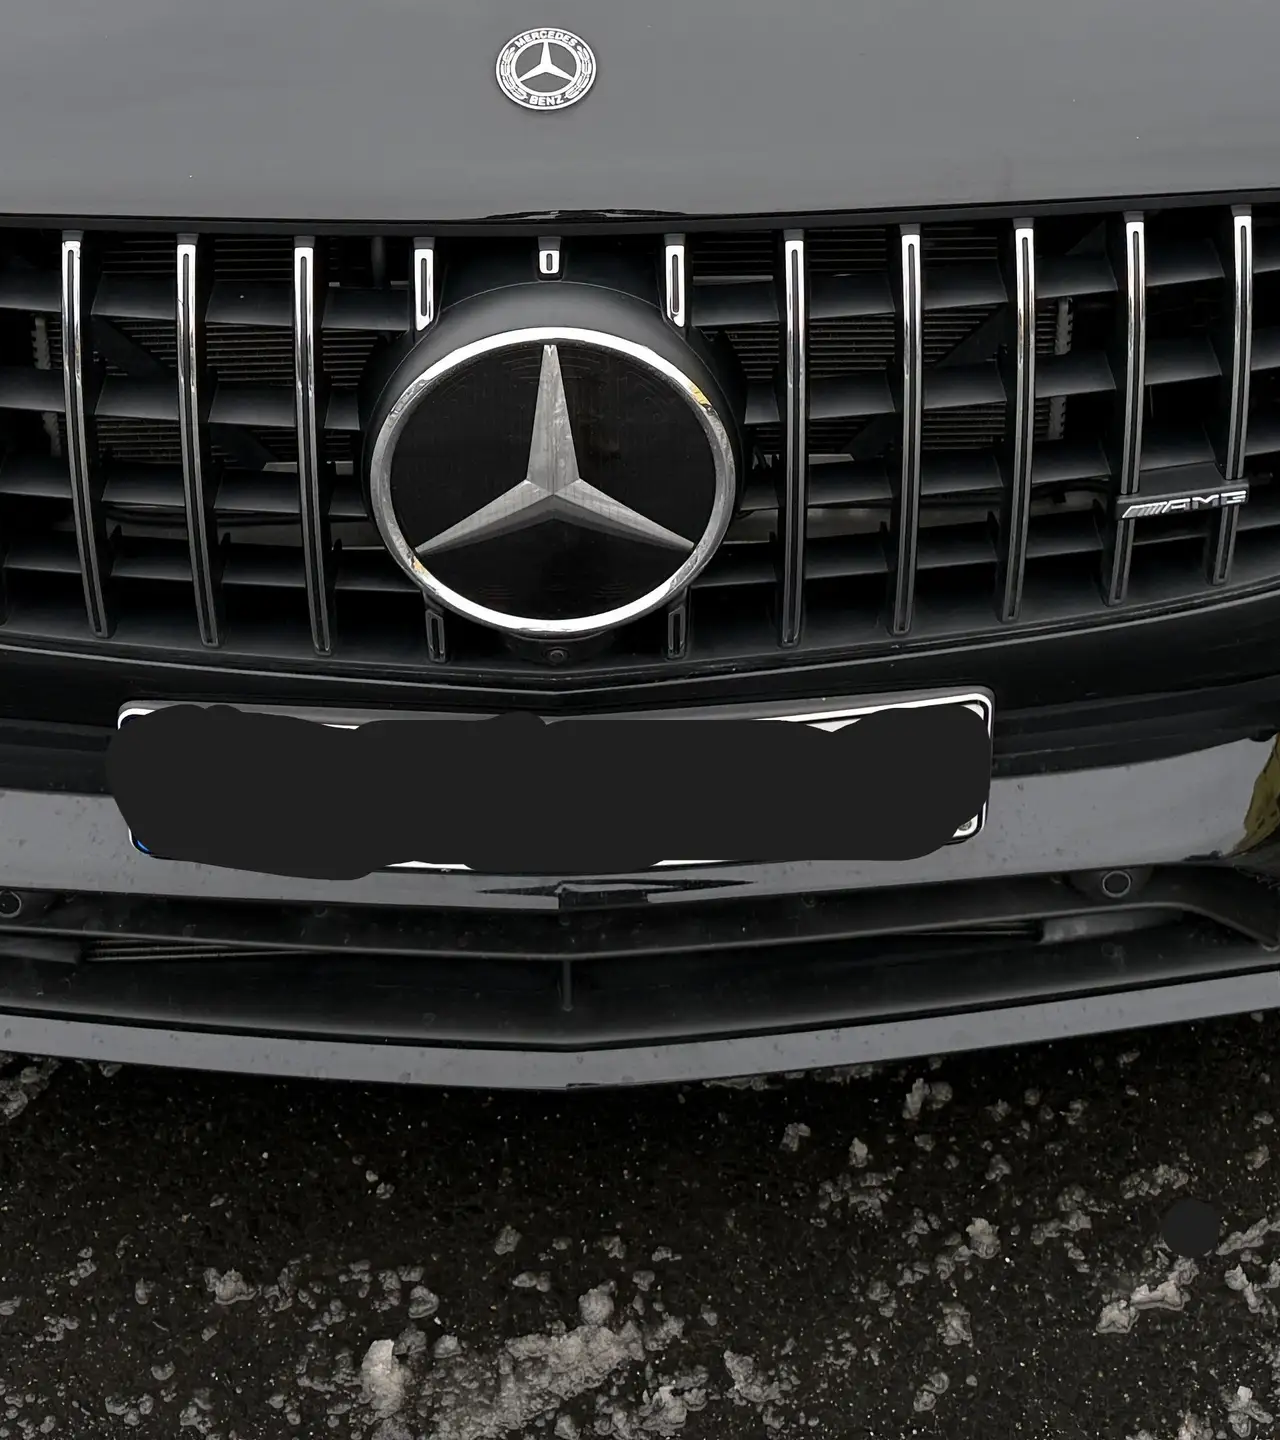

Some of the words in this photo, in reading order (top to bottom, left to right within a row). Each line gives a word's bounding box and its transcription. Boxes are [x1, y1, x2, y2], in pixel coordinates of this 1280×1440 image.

[514, 30, 578, 48] MERCEDES
[529, 94, 566, 107] BENZ
[1162, 490, 1248, 514] AMG
